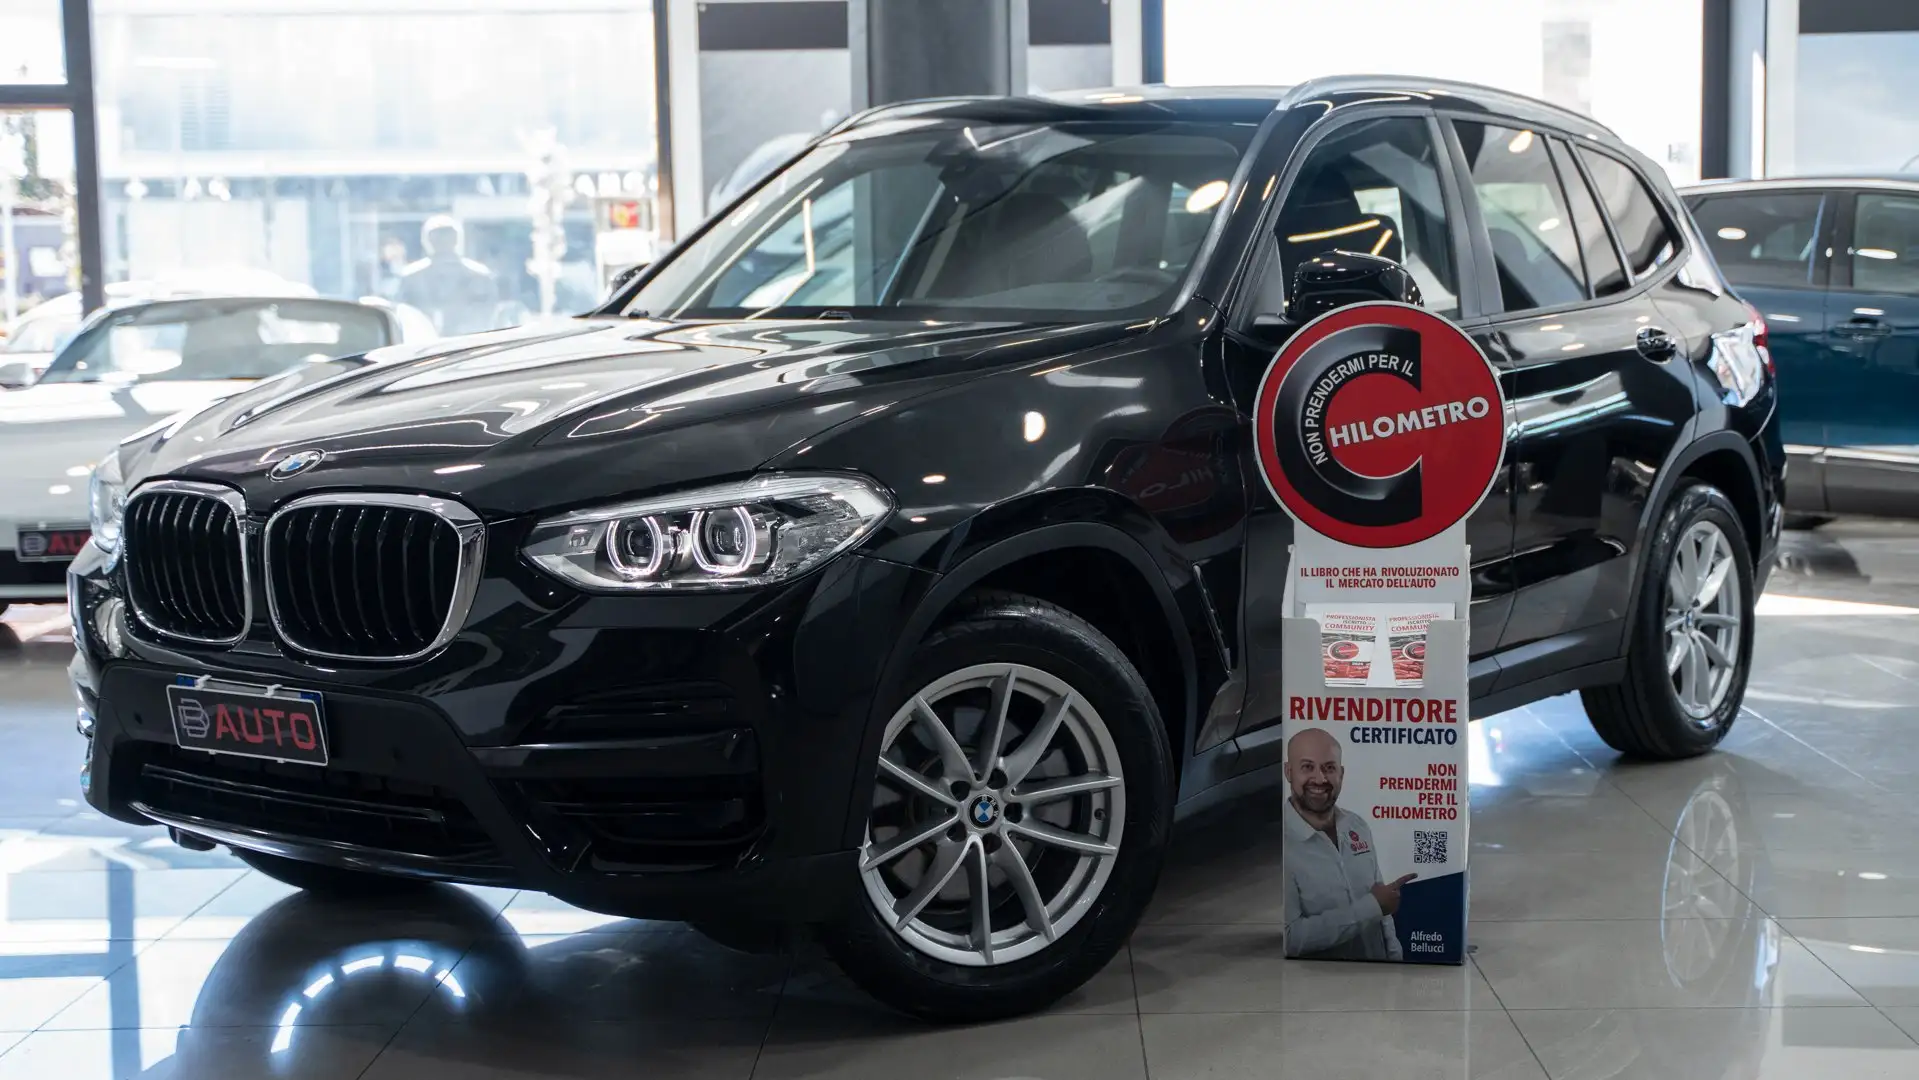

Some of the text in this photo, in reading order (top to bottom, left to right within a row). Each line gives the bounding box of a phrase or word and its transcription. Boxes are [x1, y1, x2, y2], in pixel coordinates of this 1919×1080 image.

[1305, 354, 1414, 465] NON PRENDERMI PER IL
[1329, 396, 1489, 448] HILOMETRO
[1300, 567, 1459, 577] IL LIBRO CHE HA RIVOLUZIONATO
[1325, 578, 1436, 588] IL MERCATO DELL'AUTO
[1325, 623, 1375, 631] COMMUNITY
[1290, 696, 1457, 723] RIVENDITORE
[216, 703, 317, 750] AUTO
[1350, 726, 1457, 745] CERTIFICATO
[1428, 763, 1457, 776] NON
[1380, 777, 1457, 791] PRENDERMI
[1418, 793, 1458, 806] PER IL
[1372, 806, 1457, 820] CHILOMETRO
[1411, 931, 1442, 942] Alfredo
[1411, 943, 1444, 953] Bellucci
